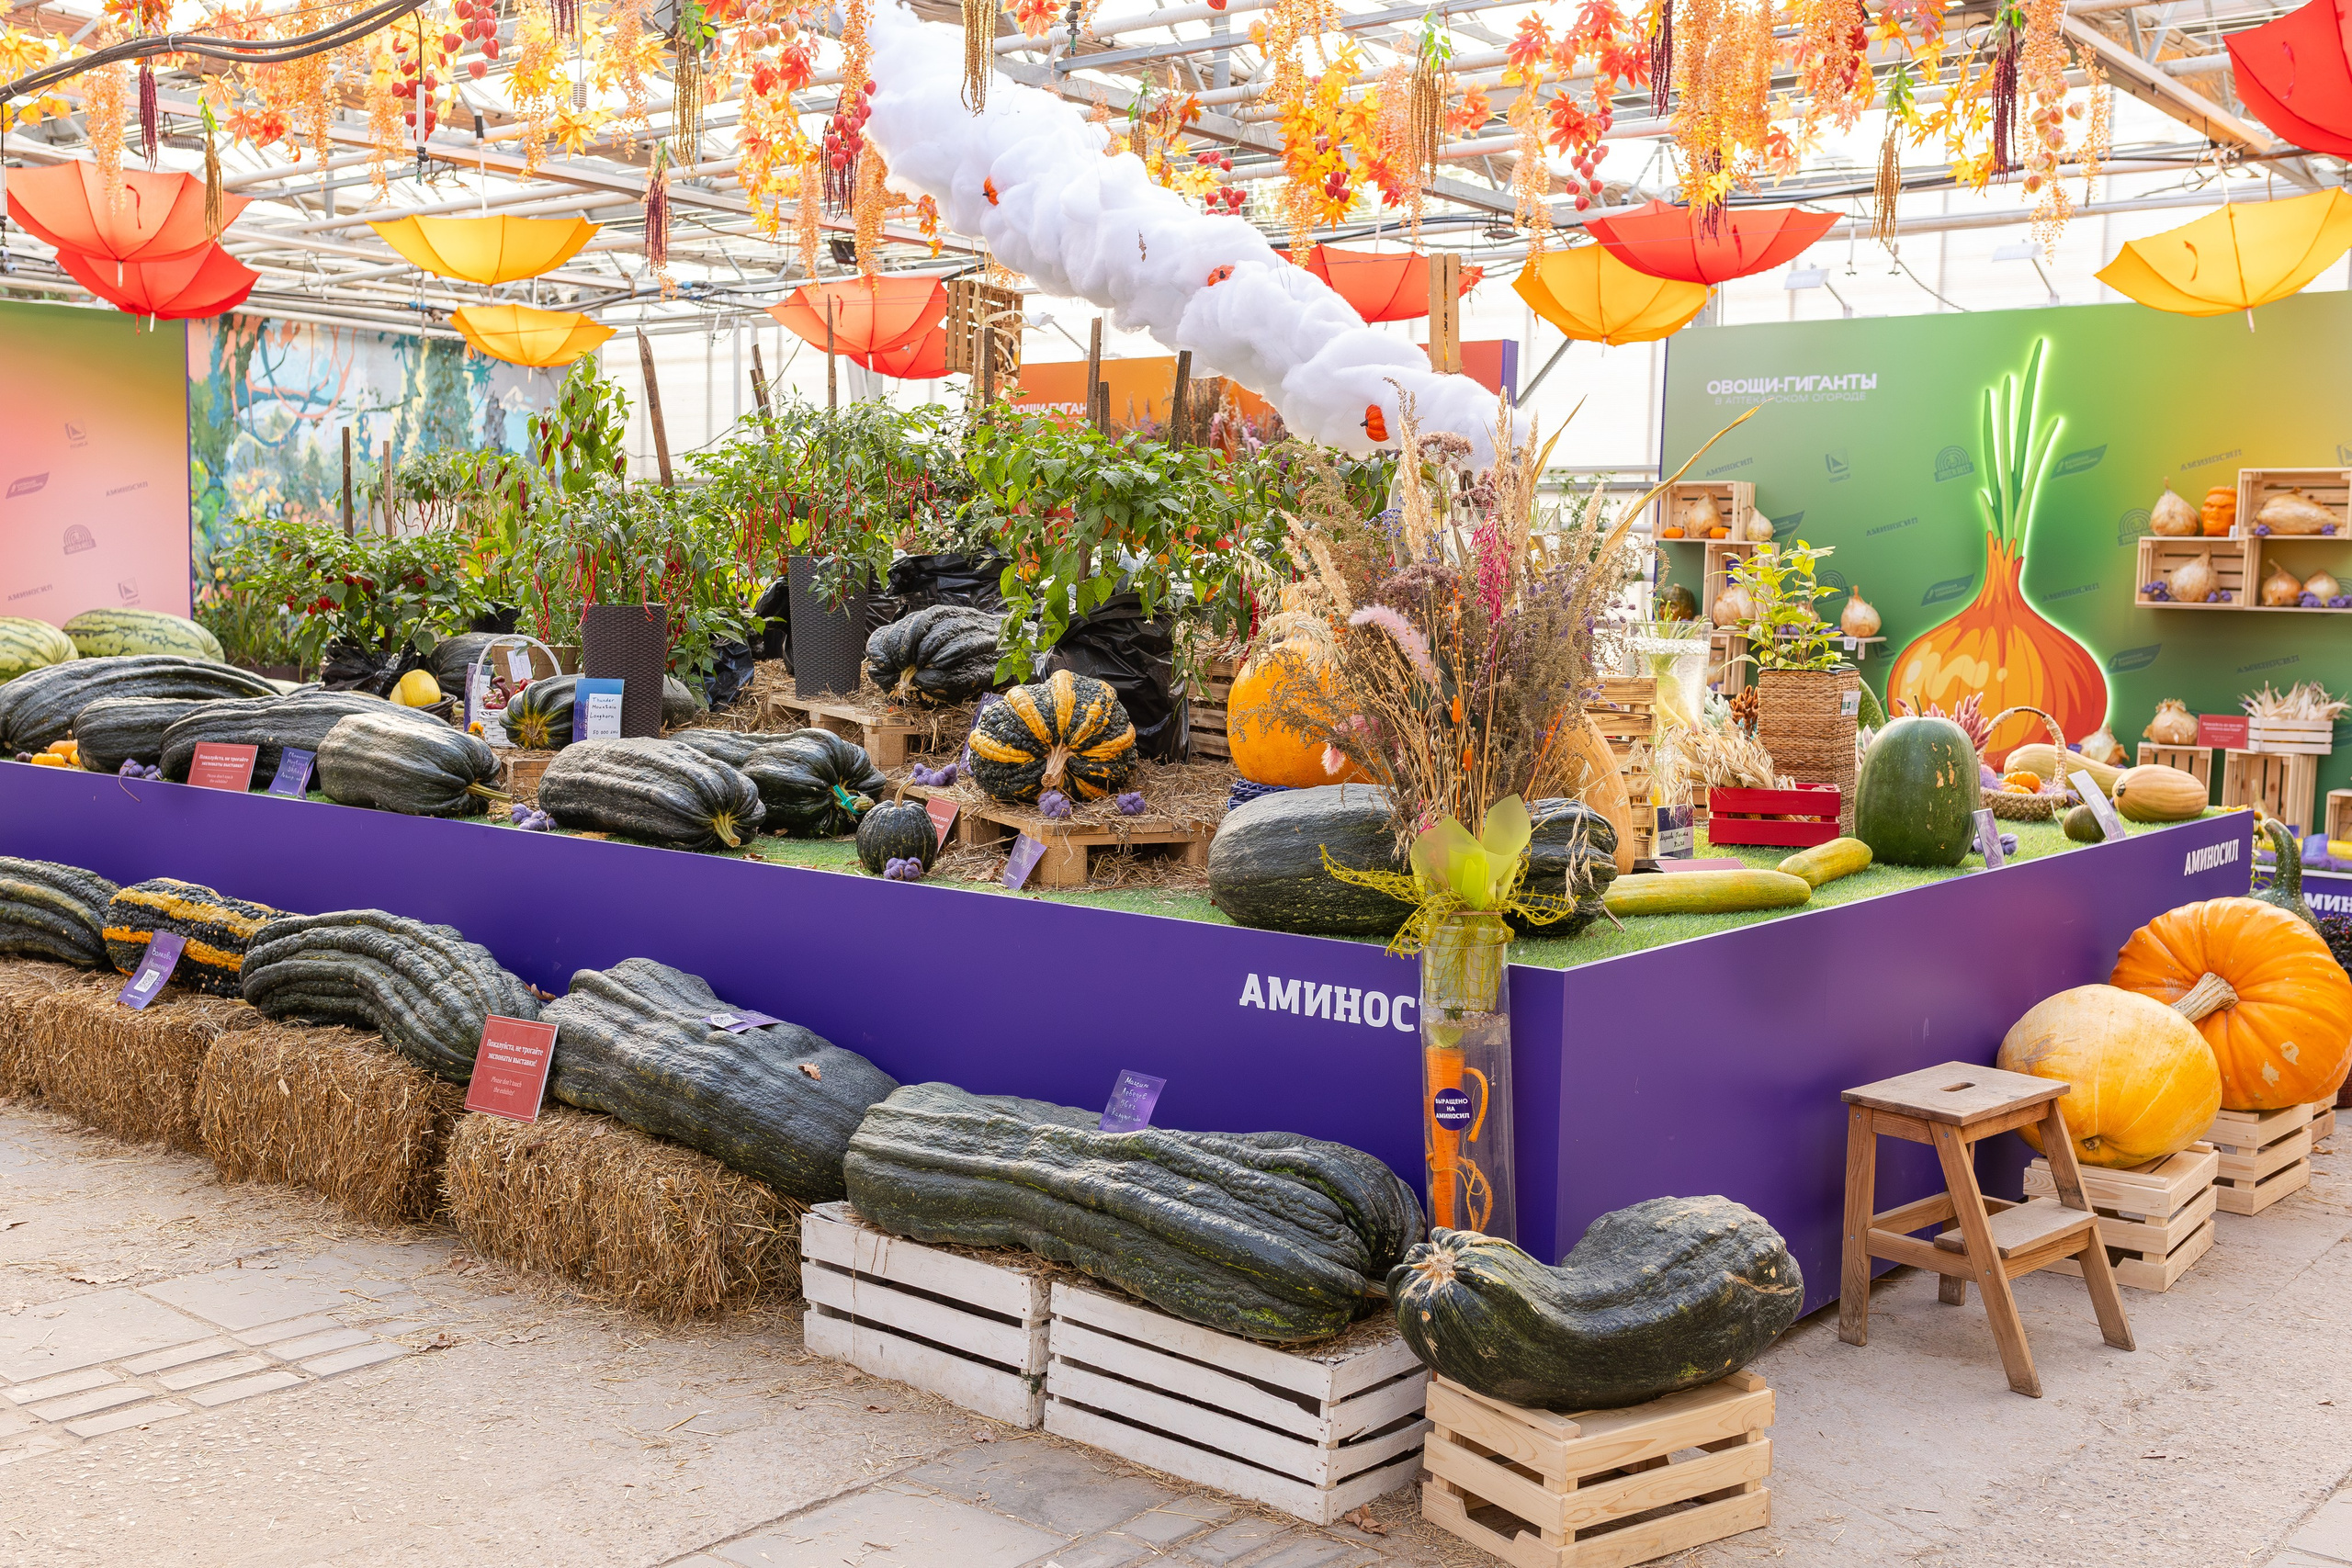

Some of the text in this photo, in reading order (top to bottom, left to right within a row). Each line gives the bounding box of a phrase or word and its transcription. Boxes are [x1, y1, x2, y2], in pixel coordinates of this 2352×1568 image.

[1706, 372, 1877, 395] ОВОЩИ-ГИГАНТЫ
[1715, 391, 1867, 405] В АПТЕКАСКОМ ОГОРОДЕ
[590, 712, 615, 721] Longhorn
[2184, 838, 2240, 876] АМИНОСИЛ
[2302, 892, 2352, 914] МИН
[1239, 973, 1421, 1033] АМИНОС
[487, 1038, 514, 1052] Пожалуйста,
[522, 1046, 544, 1056] трогайте
[488, 1052, 537, 1067] экспонаты выставки!
[491, 1076, 522, 1089] Please don't touch
[1120, 1087, 1148, 1102] Лебедев
